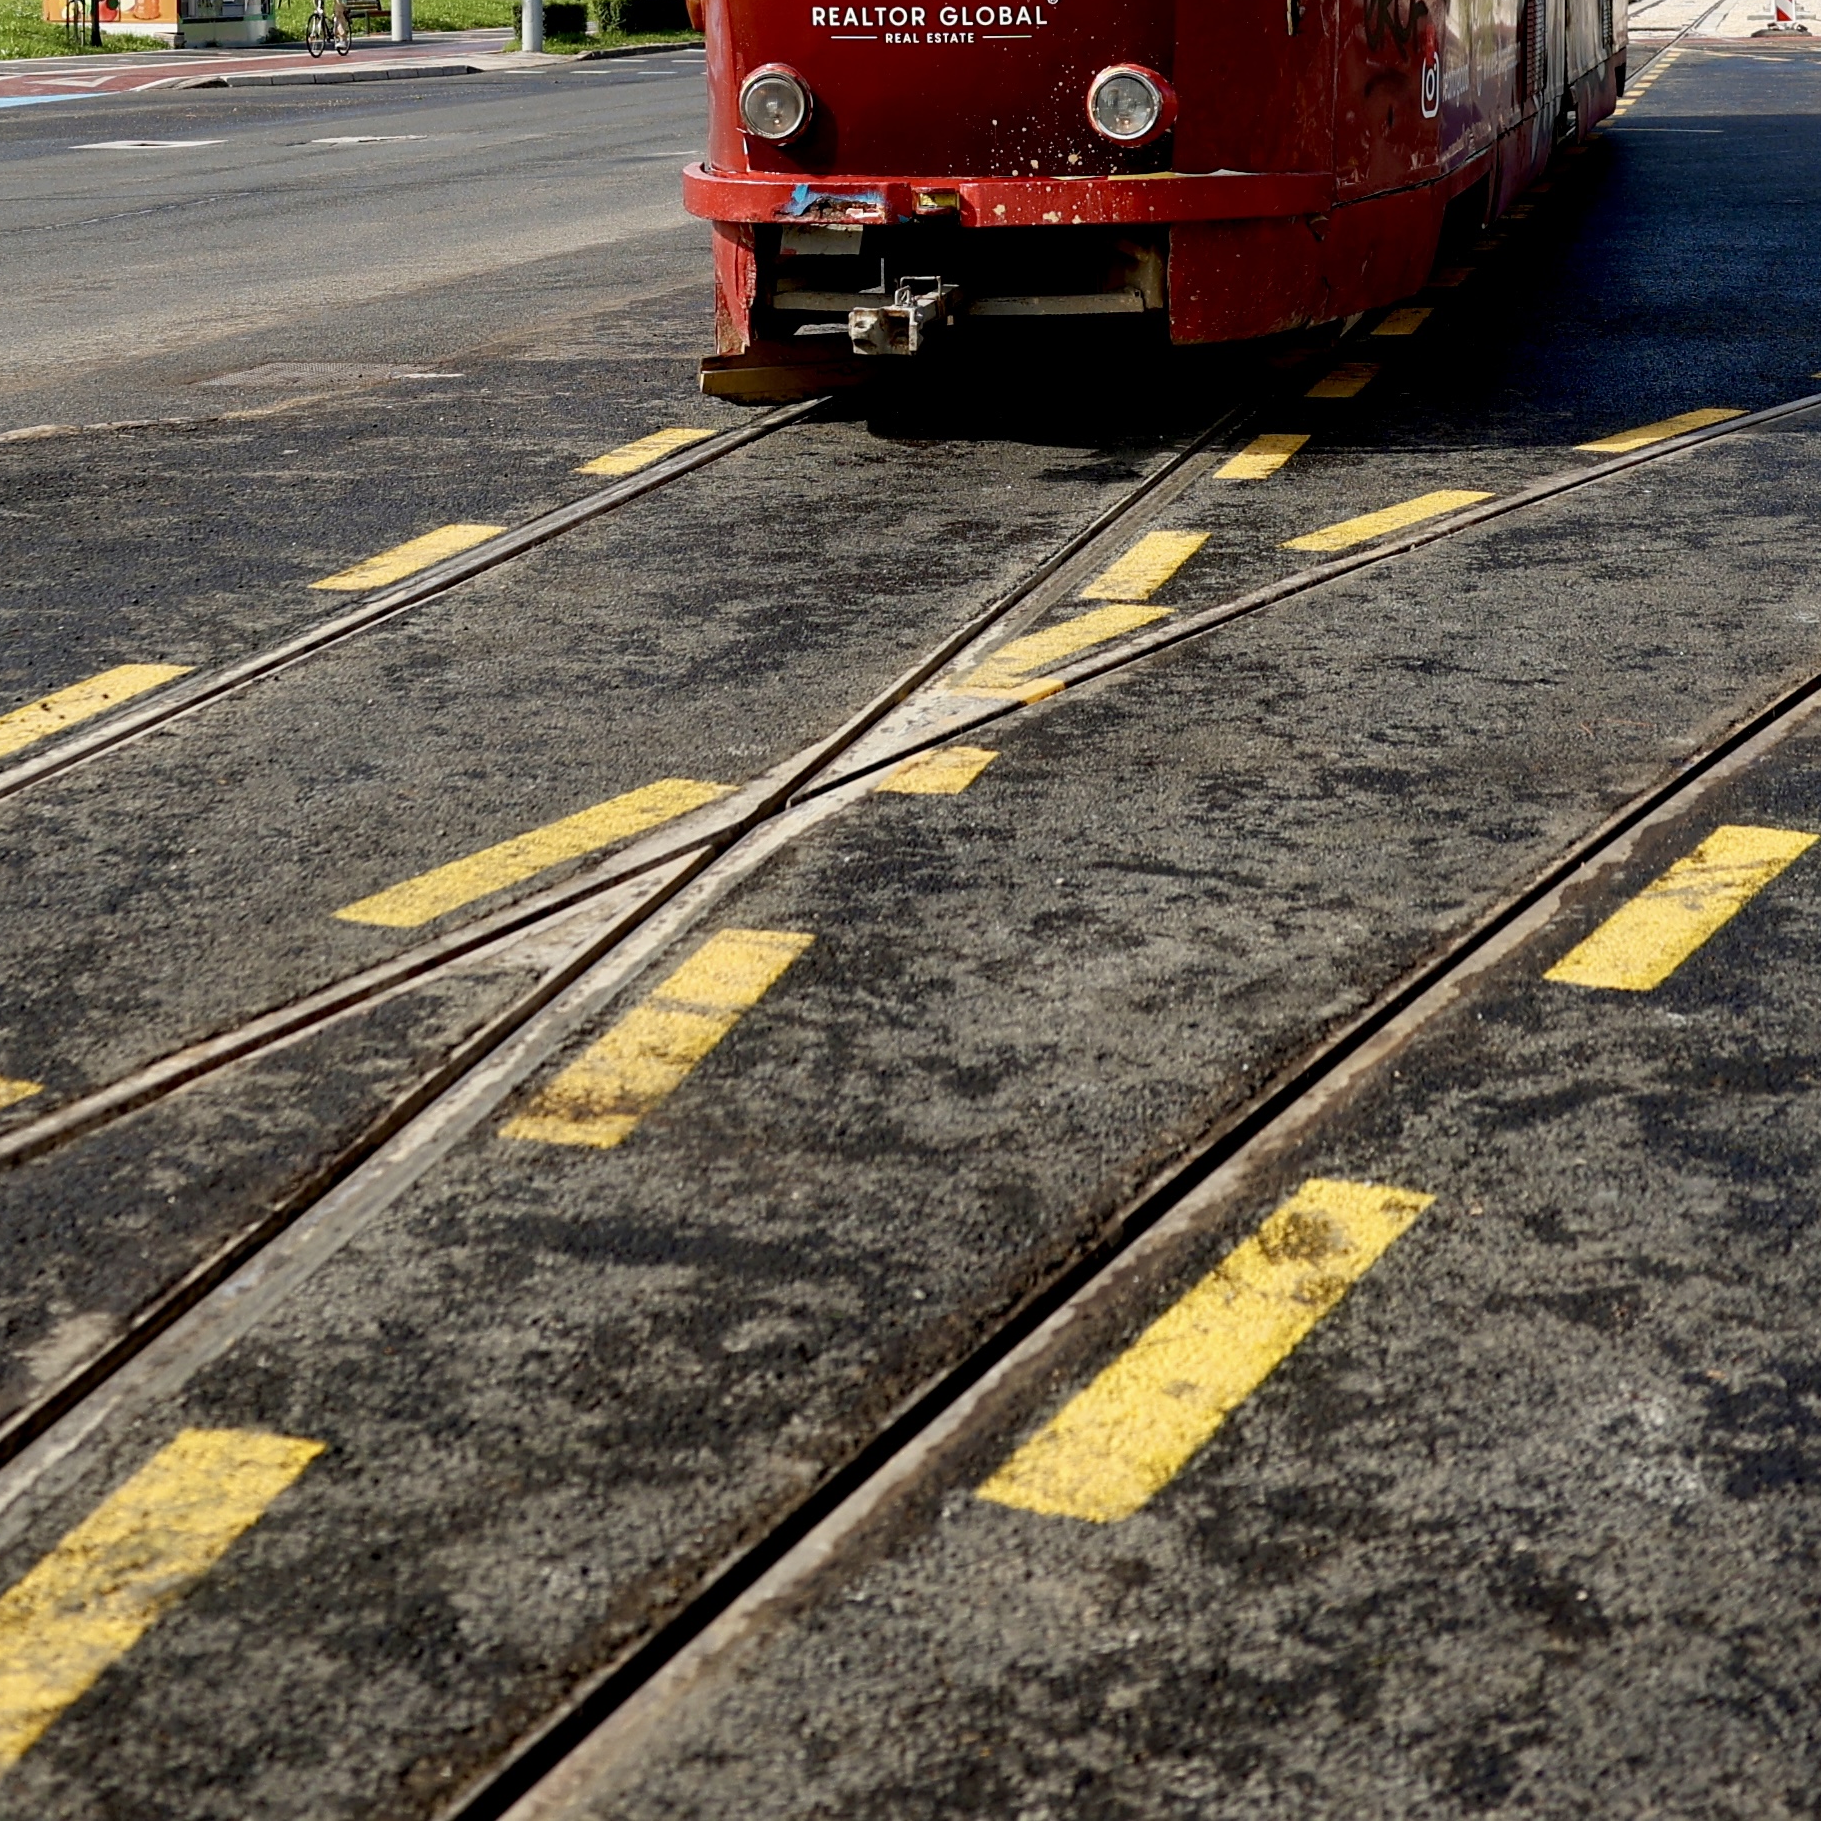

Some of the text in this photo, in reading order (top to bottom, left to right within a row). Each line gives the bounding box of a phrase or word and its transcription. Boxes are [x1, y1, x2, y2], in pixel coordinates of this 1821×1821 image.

[811, 5, 1048, 27] REALTOR GLOBAL
[885, 31, 975, 44] REAL ESTATE
